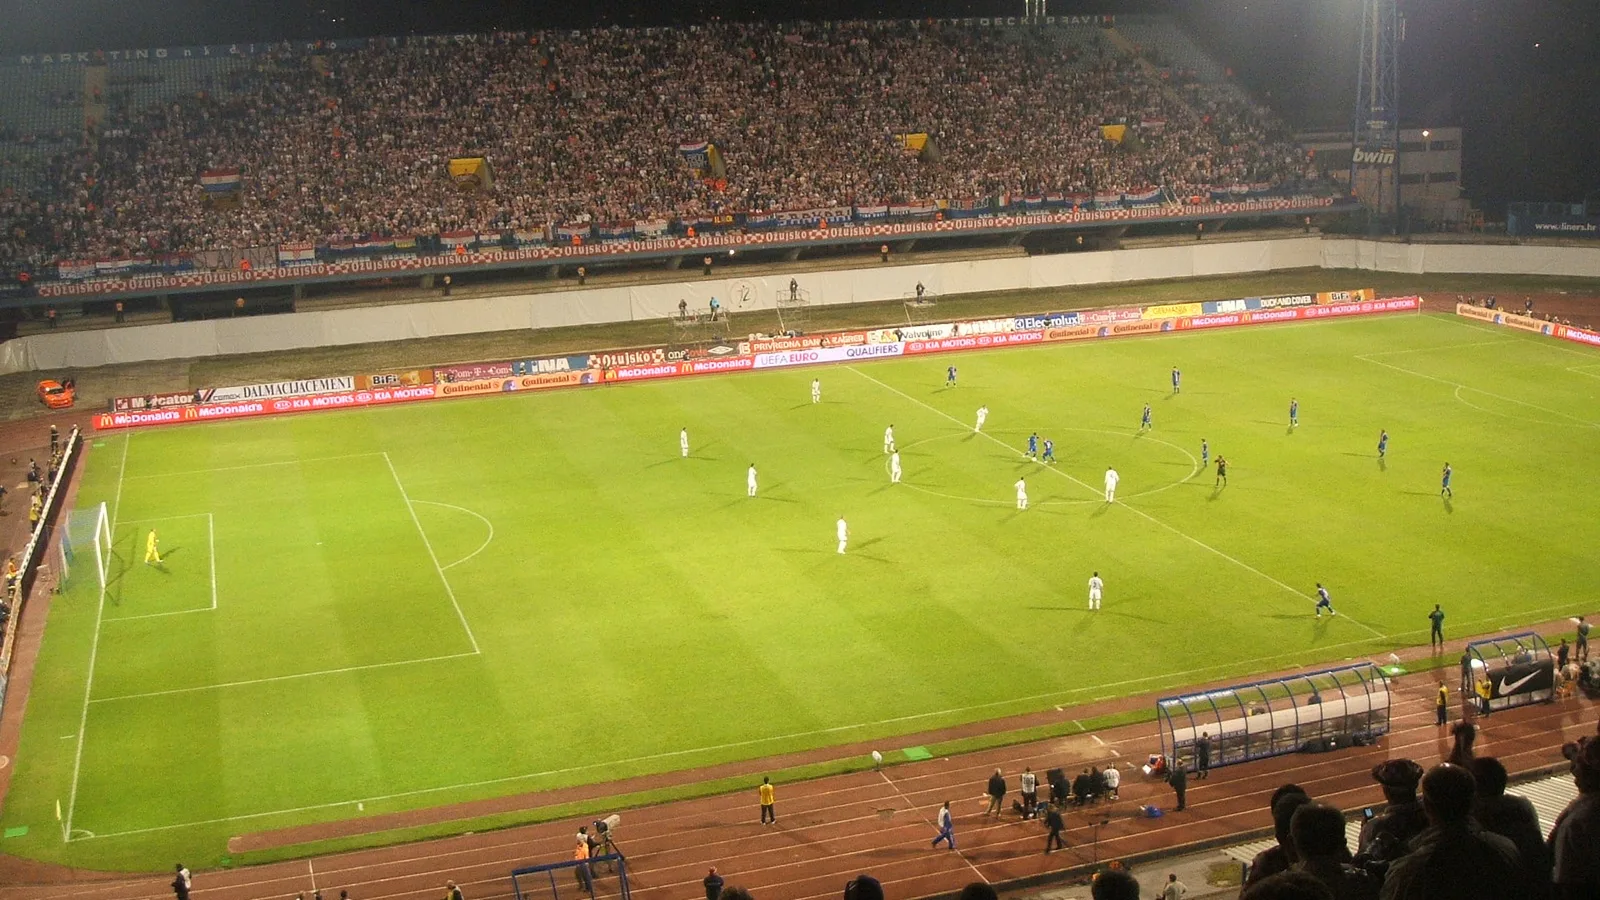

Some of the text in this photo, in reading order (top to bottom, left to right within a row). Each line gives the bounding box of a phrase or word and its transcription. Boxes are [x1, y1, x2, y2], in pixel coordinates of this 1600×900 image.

[21, 47, 168, 64] MARKTING
[1352, 148, 1395, 164] bwin
[1291, 295, 1312, 305] COVER
[1192, 315, 1239, 326] McDonald's
[1252, 310, 1297, 321] McDonald's
[1025, 315, 1078, 330] Elecrolux
[1113, 322, 1153, 334] Continental
[993, 335, 1007, 344] KIA
[1009, 332, 1042, 342] MOTORS
[1050, 328, 1089, 339] Continental
[925, 340, 940, 350] KIA
[942, 337, 976, 348] MOTORS
[761, 344, 899, 366] UEFA EURO QUALIFIERS
[618, 365, 677, 378] McDonald's
[693, 358, 751, 372] McDonald's
[372, 373, 397, 385] BiFi
[521, 374, 569, 388] Continental
[243, 376, 351, 398] DALMACIJACEMENT
[374, 390, 391, 400] KIA
[394, 387, 434, 398] MOTORS
[443, 382, 491, 395] Continental
[293, 398, 310, 408] KIA
[313, 394, 354, 406] MOTORS
[199, 404, 263, 417] McDonald's
[114, 411, 180, 425] McDonald's
